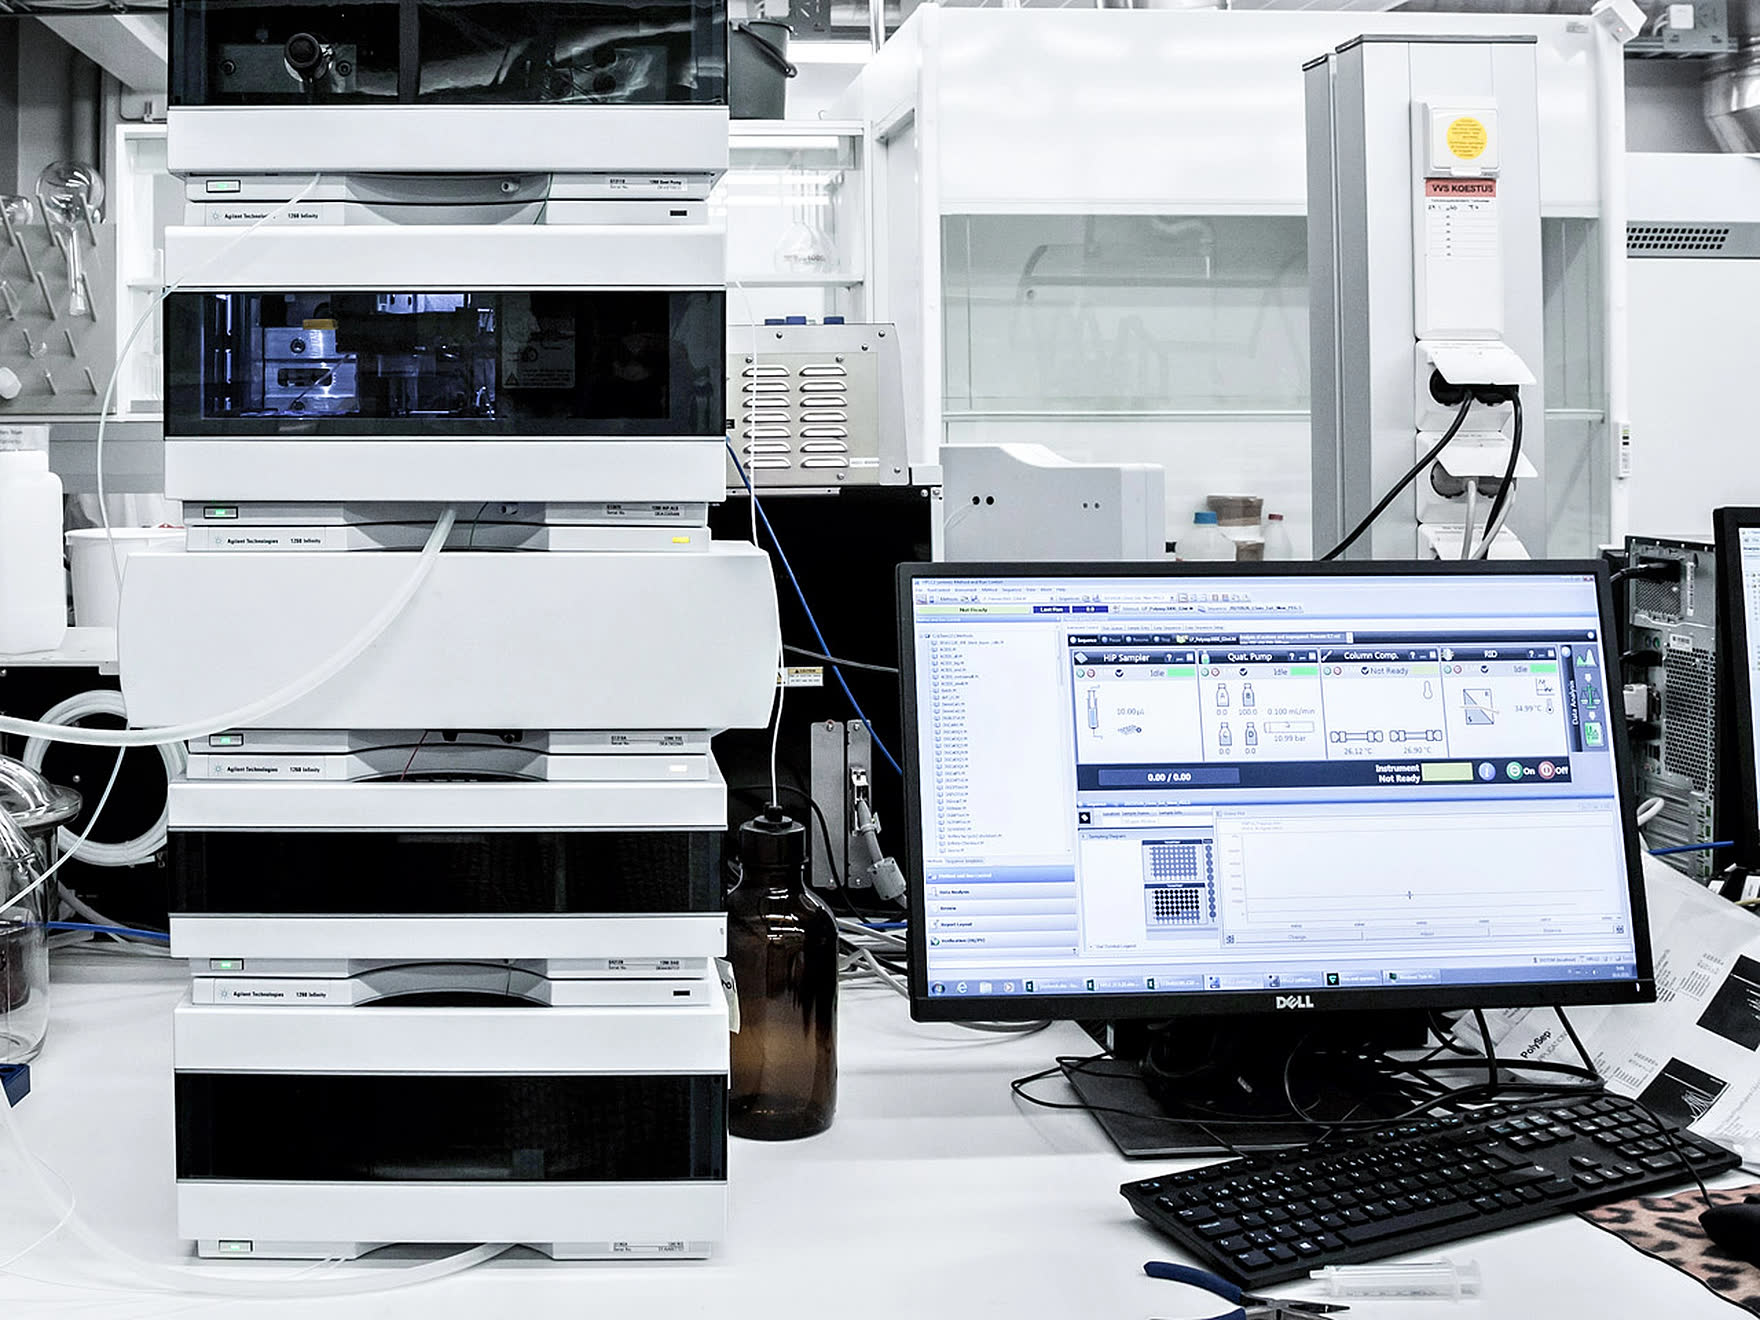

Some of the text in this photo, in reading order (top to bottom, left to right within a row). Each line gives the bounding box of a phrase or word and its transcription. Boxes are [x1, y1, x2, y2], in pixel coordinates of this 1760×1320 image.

[1432, 184, 1494, 192] VVS KOESTUS
[1118, 653, 1150, 664] Sampler
[1250, 652, 1273, 662] Pump
[1344, 651, 1399, 660] Column Comp.
[1484, 650, 1498, 658] RID
[1150, 669, 1165, 677] Idle
[1274, 668, 1288, 676] Idle
[1386, 667, 1408, 676] Ready
[1376, 764, 1420, 773] Instrument
[1523, 767, 1536, 776] On
[1555, 766, 1568, 774] Off
[1148, 772, 1166, 782] 0.00
[1173, 772, 1192, 782] 0.00
[1378, 774, 1421, 784] Not Ready
[1276, 995, 1314, 1010] DELL
[1520, 1030, 1552, 1059] PolySep
